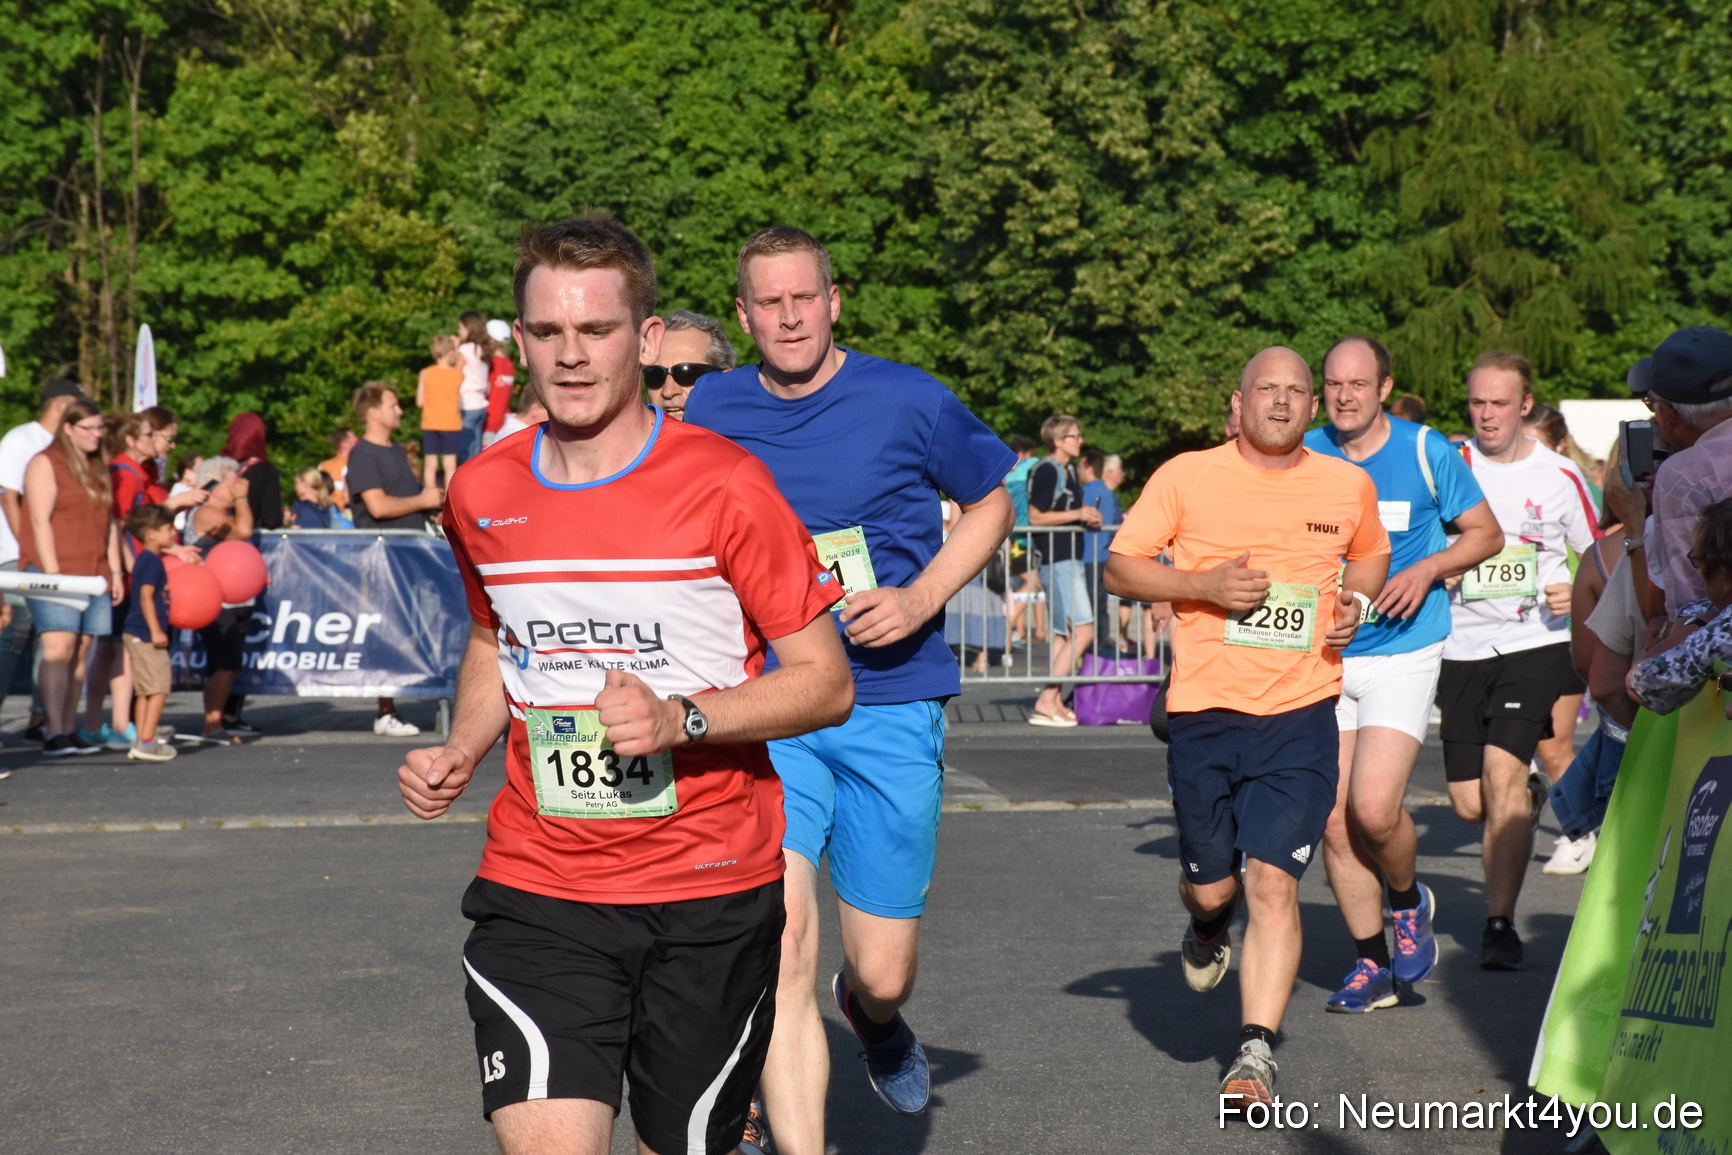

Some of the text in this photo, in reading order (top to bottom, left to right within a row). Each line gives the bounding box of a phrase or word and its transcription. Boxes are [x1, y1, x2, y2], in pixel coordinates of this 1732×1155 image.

[1306, 522, 1340, 535] THULE
[841, 548, 860, 558] 2019
[1472, 563, 1526, 583] 1789
[1238, 626, 1302, 640] Effhauser Christian
[170, 651, 362, 670] AUMOBILE
[629, 657, 670, 671] KLIMA
[546, 731, 599, 742] firmenlauf
[547, 749, 654, 788] 1834
[571, 789, 633, 800] Seitz Lukas
[585, 801, 605, 810] Petry
[1687, 807, 1719, 838] Fischer
[1189, 862, 1200, 873] EC
[483, 1050, 506, 1084] LS
